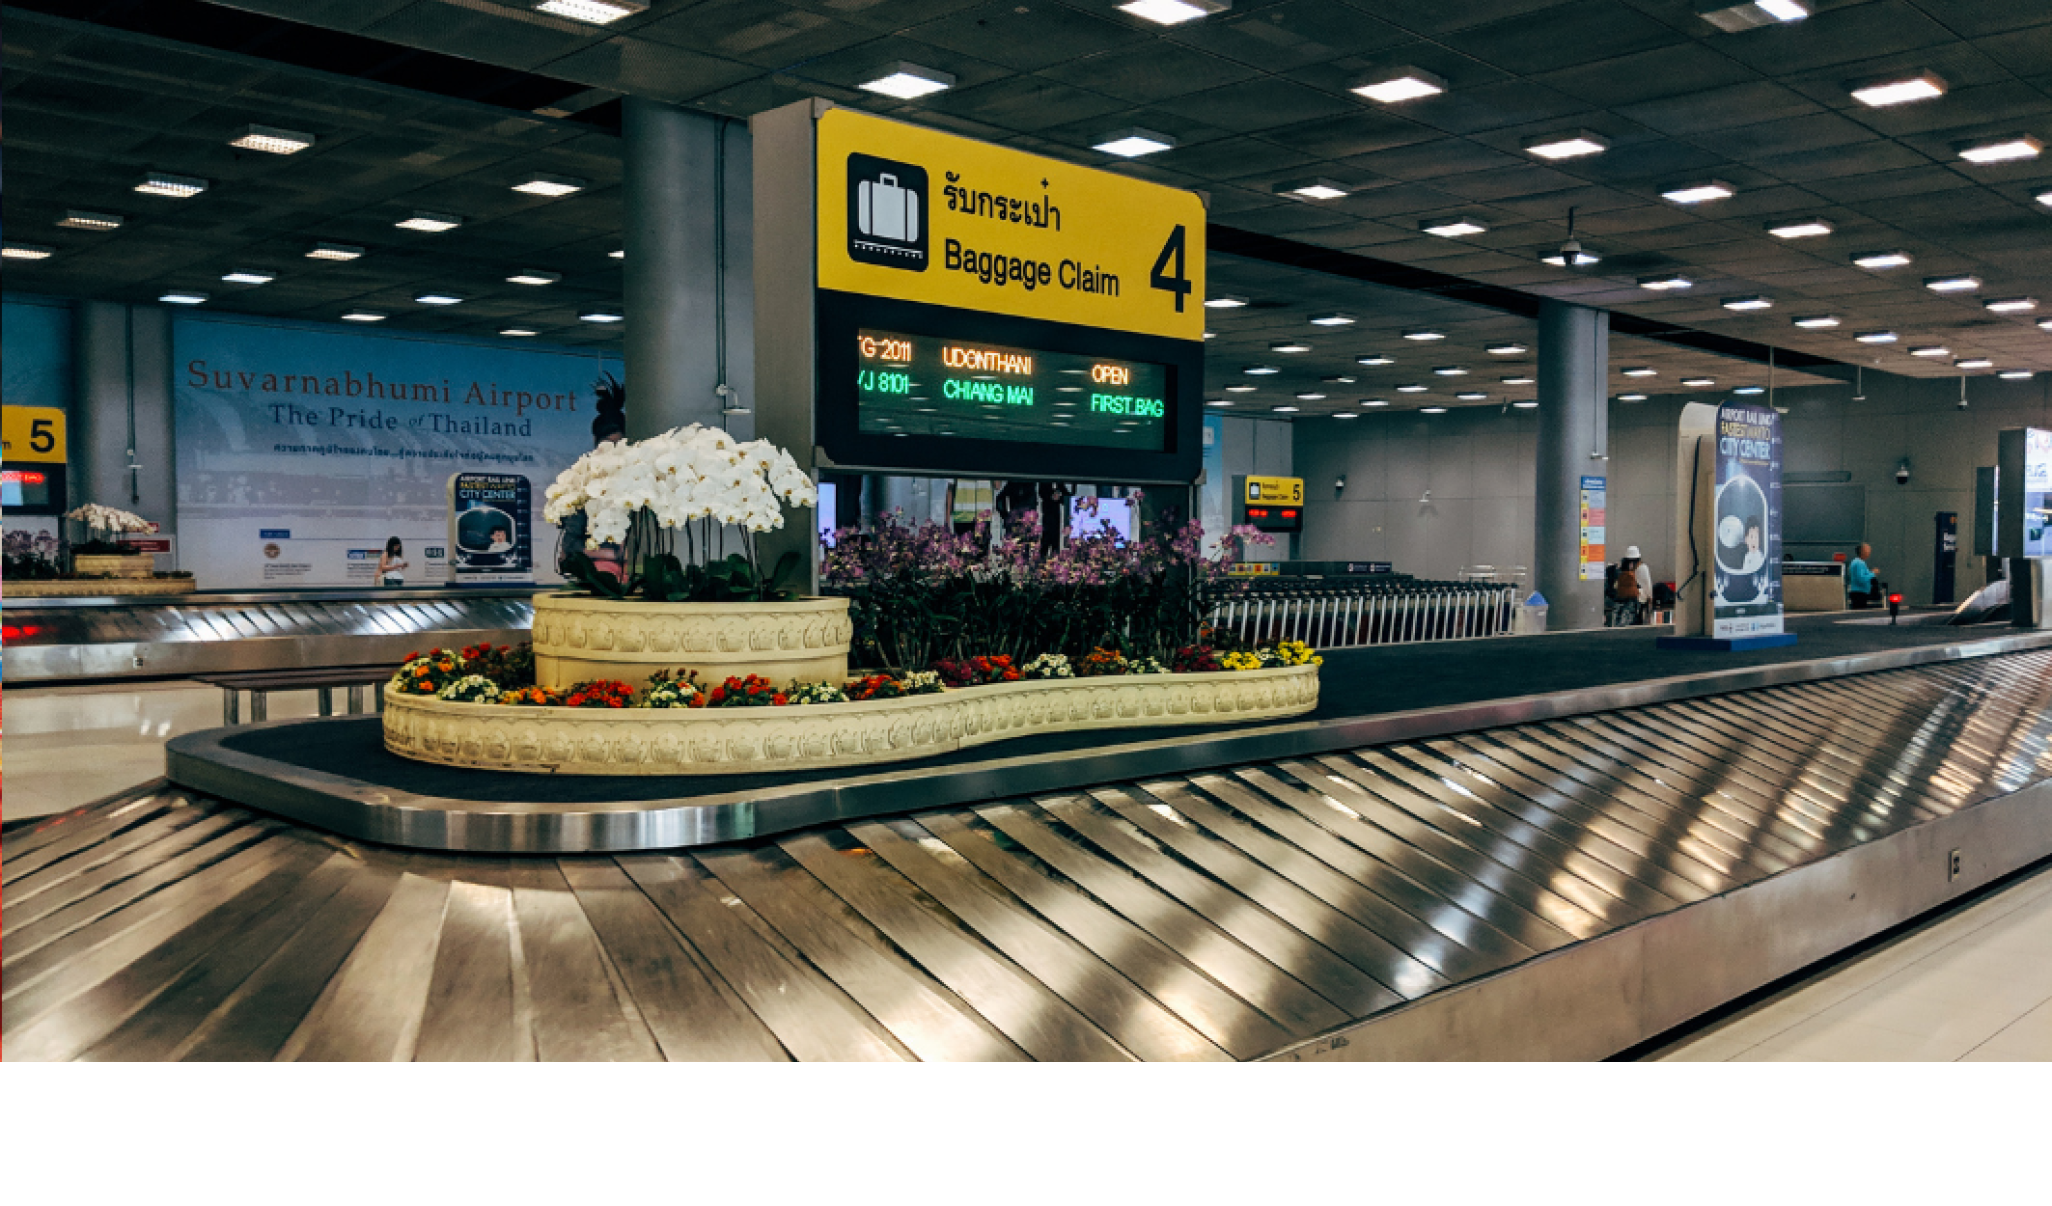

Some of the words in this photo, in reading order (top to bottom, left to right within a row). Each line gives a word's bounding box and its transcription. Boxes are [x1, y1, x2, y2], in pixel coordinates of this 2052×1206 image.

[943, 170, 1061, 232] รับกระเป๋า
[945, 238, 1051, 292] Baggage
[1058, 258, 1120, 297] Claim
[1150, 223, 1192, 313] 4
[879, 339, 912, 362] 2011
[942, 346, 1032, 375] UDONTHANI
[1092, 364, 1130, 386] OPEN
[188, 359, 451, 404] Suvarnabhumi
[464, 377, 577, 417] Airport
[878, 371, 910, 394] 8101
[943, 378, 1004, 403] CHIANG
[1006, 385, 1034, 405] MAI
[1091, 393, 1133, 414] FIRST
[1134, 397, 1165, 417] BAG
[30, 418, 55, 453] 5
[268, 402, 319, 427] The
[329, 406, 398, 430] Pride
[408, 413, 426, 428] of
[428, 411, 532, 437] Thailand
[1292, 483, 1302, 502] 5
